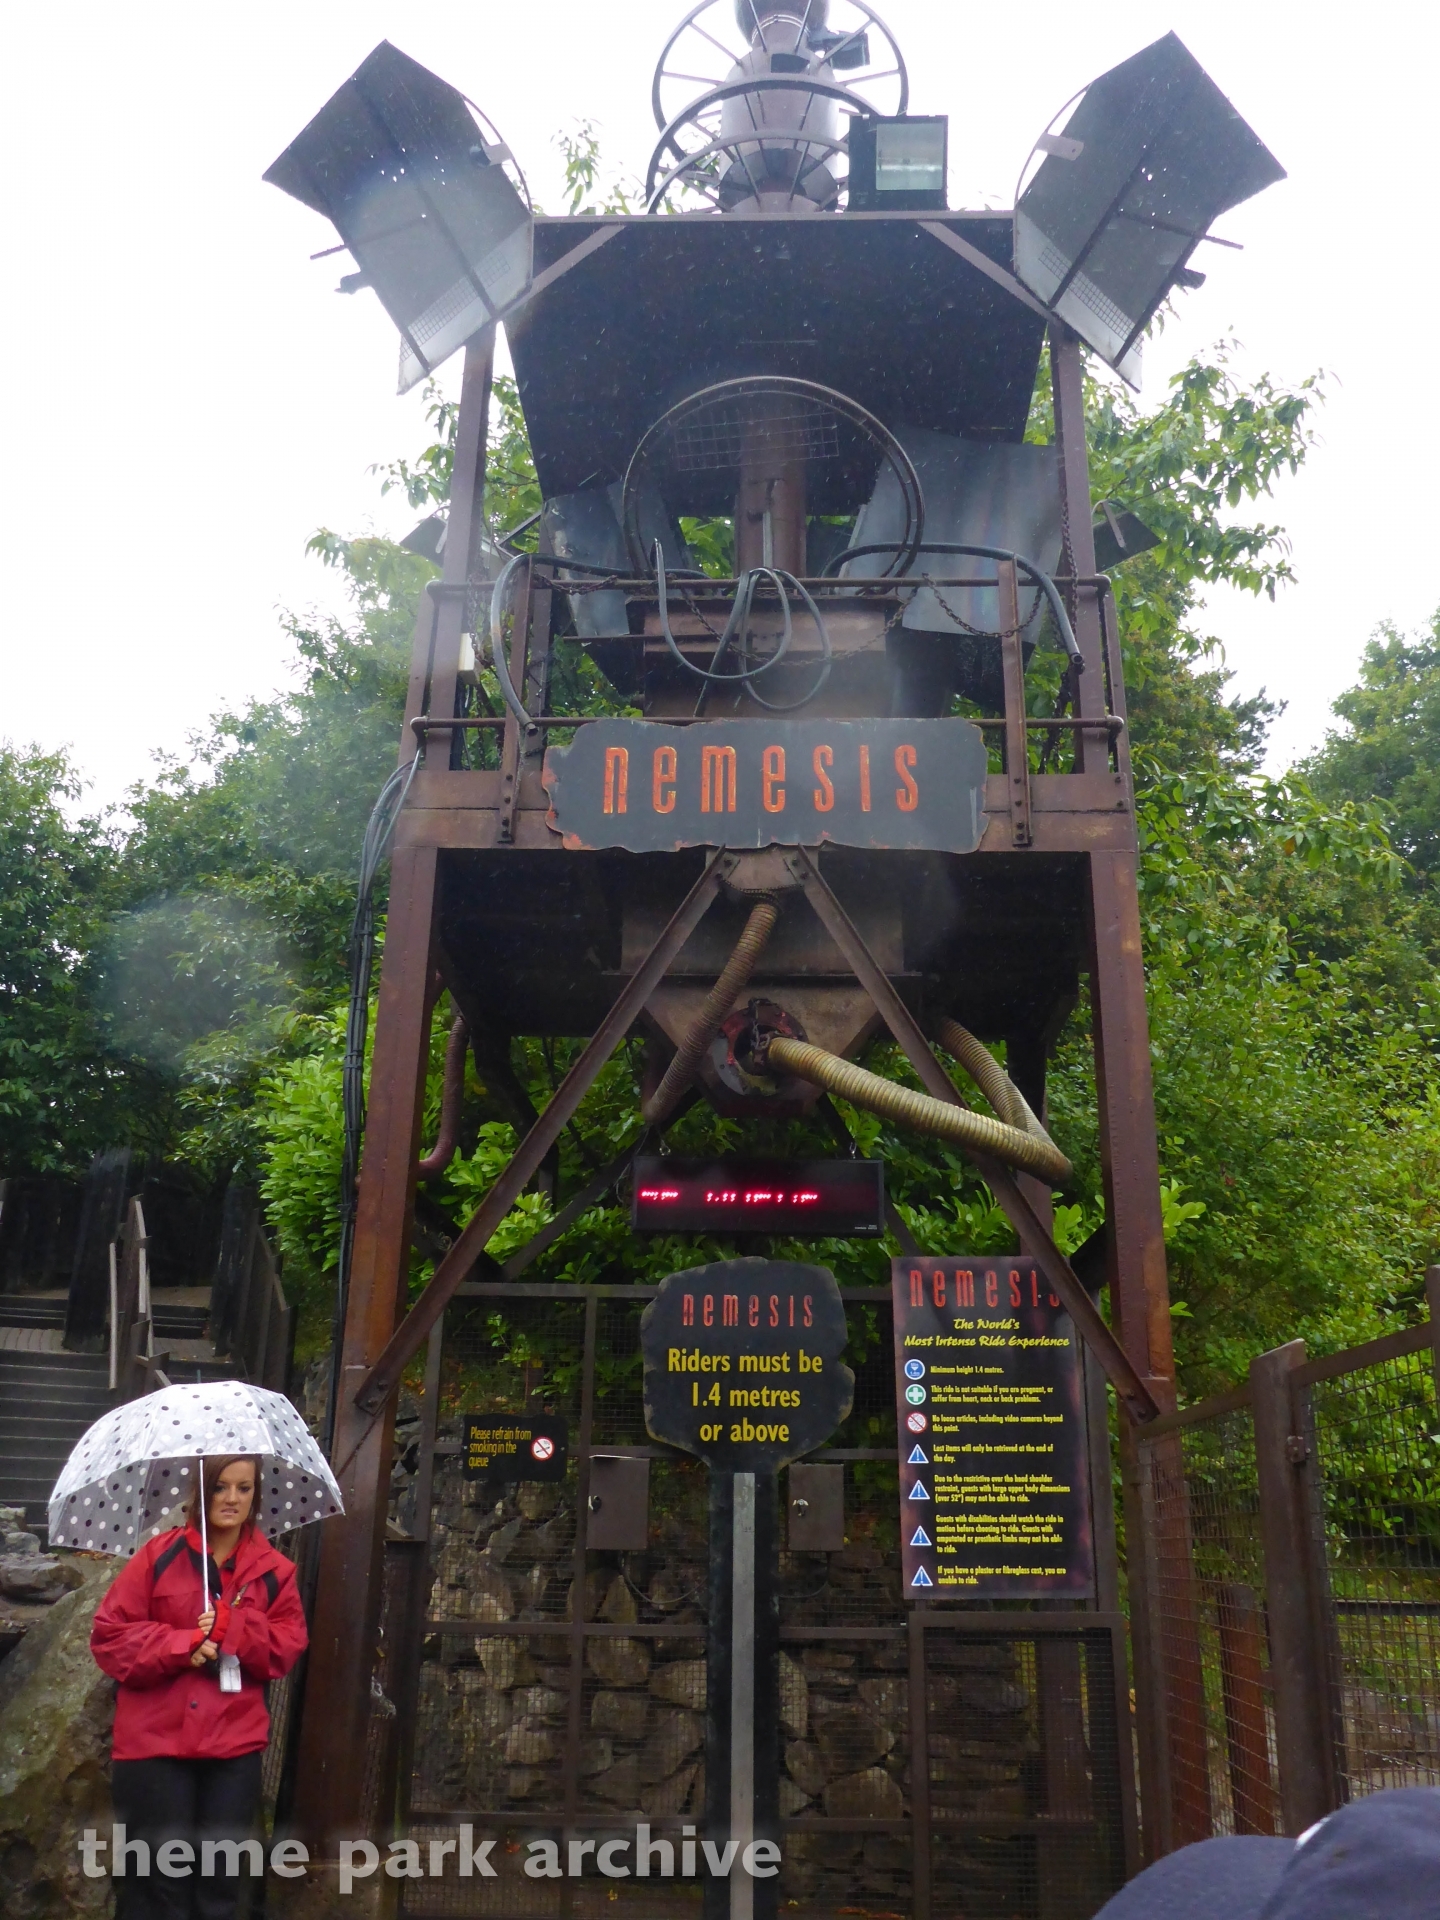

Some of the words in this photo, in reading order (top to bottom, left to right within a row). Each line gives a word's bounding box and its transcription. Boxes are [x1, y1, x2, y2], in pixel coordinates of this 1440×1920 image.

[953, 1318, 974, 1329] The
[977, 1319, 1020, 1329] World's
[904, 1336, 933, 1346] Most
[936, 1336, 976, 1346] Intense
[979, 1336, 1005, 1346] Ride
[1008, 1336, 1070, 1348] Experience
[668, 1348, 730, 1371] Riders
[740, 1352, 790, 1372] must
[800, 1349, 822, 1372] be
[693, 1382, 721, 1406] 1.4
[729, 1386, 800, 1406] metres
[471, 1427, 491, 1439] Please
[492, 1427, 514, 1439] refrain
[515, 1427, 531, 1440] from
[700, 1425, 722, 1441] or
[730, 1418, 789, 1441] above
[470, 1441, 496, 1456] smoking
[498, 1441, 504, 1453] in
[506, 1441, 516, 1453] the
[469, 1457, 489, 1469] queue
